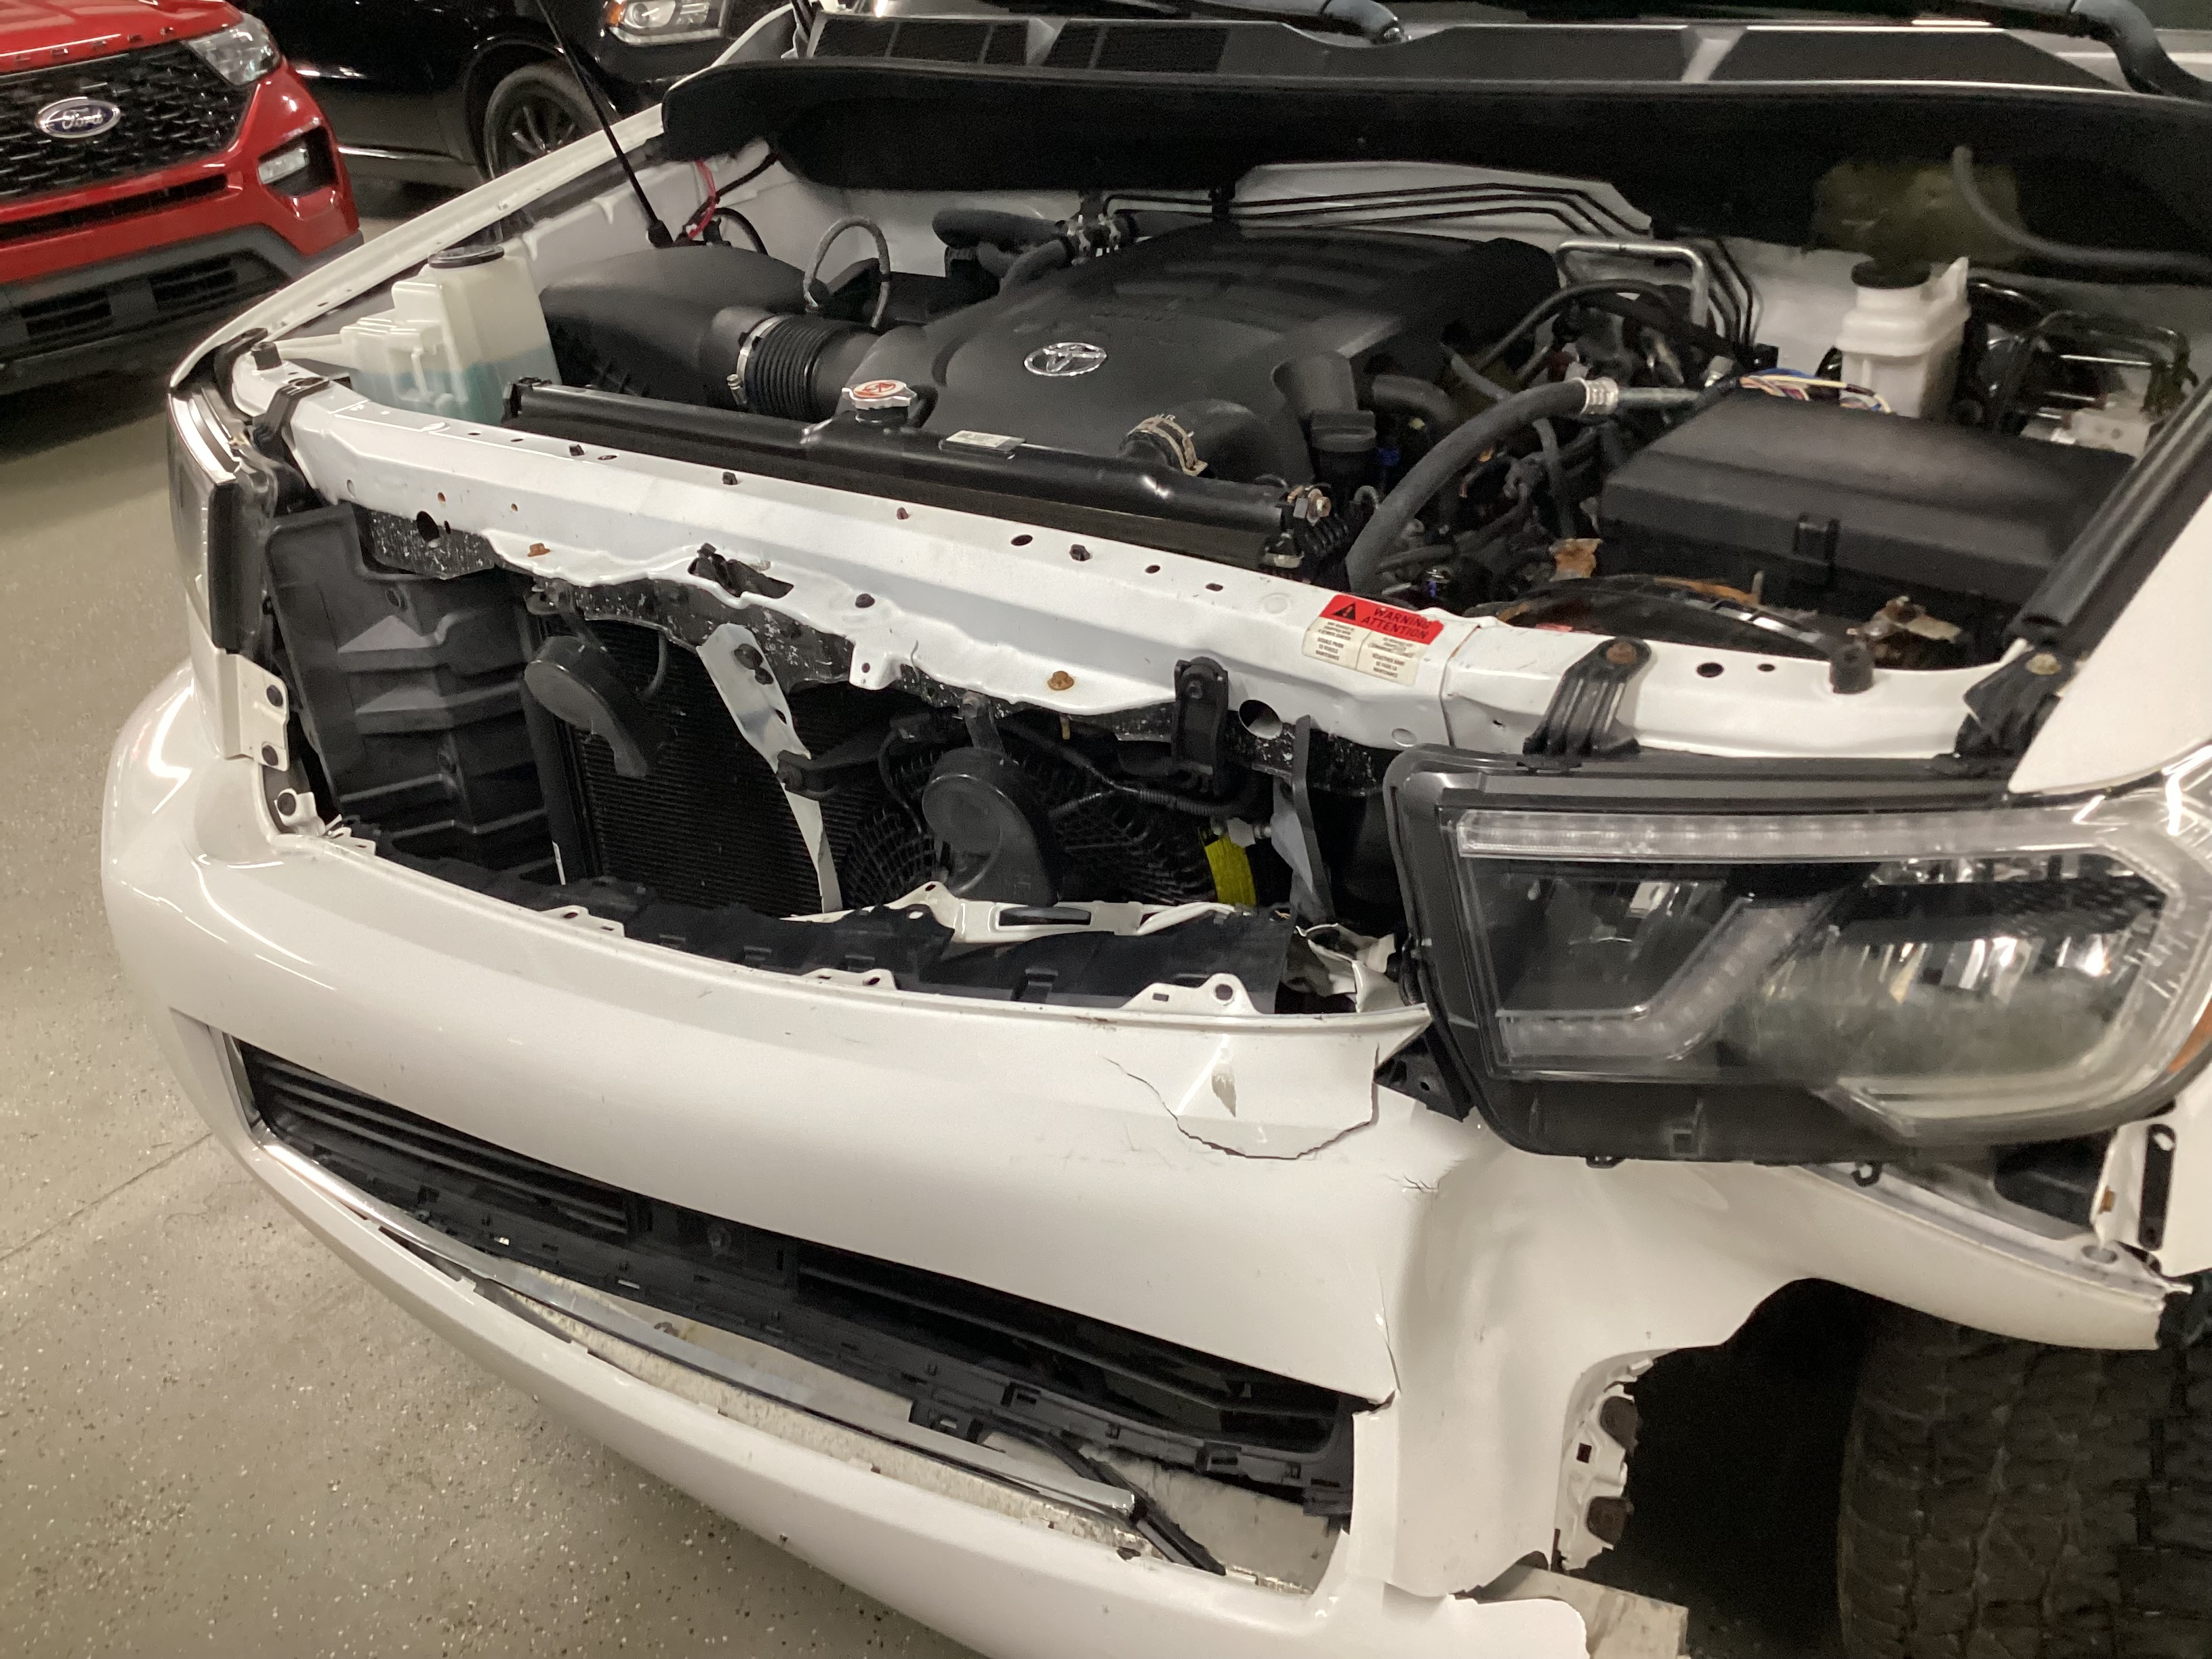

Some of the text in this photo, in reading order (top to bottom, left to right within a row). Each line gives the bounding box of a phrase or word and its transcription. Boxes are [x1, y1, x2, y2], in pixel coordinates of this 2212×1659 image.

[61, 106, 104, 130] Ford
[1361, 615, 1429, 639] ATTENTION
[1373, 607, 1432, 630] WARNING
